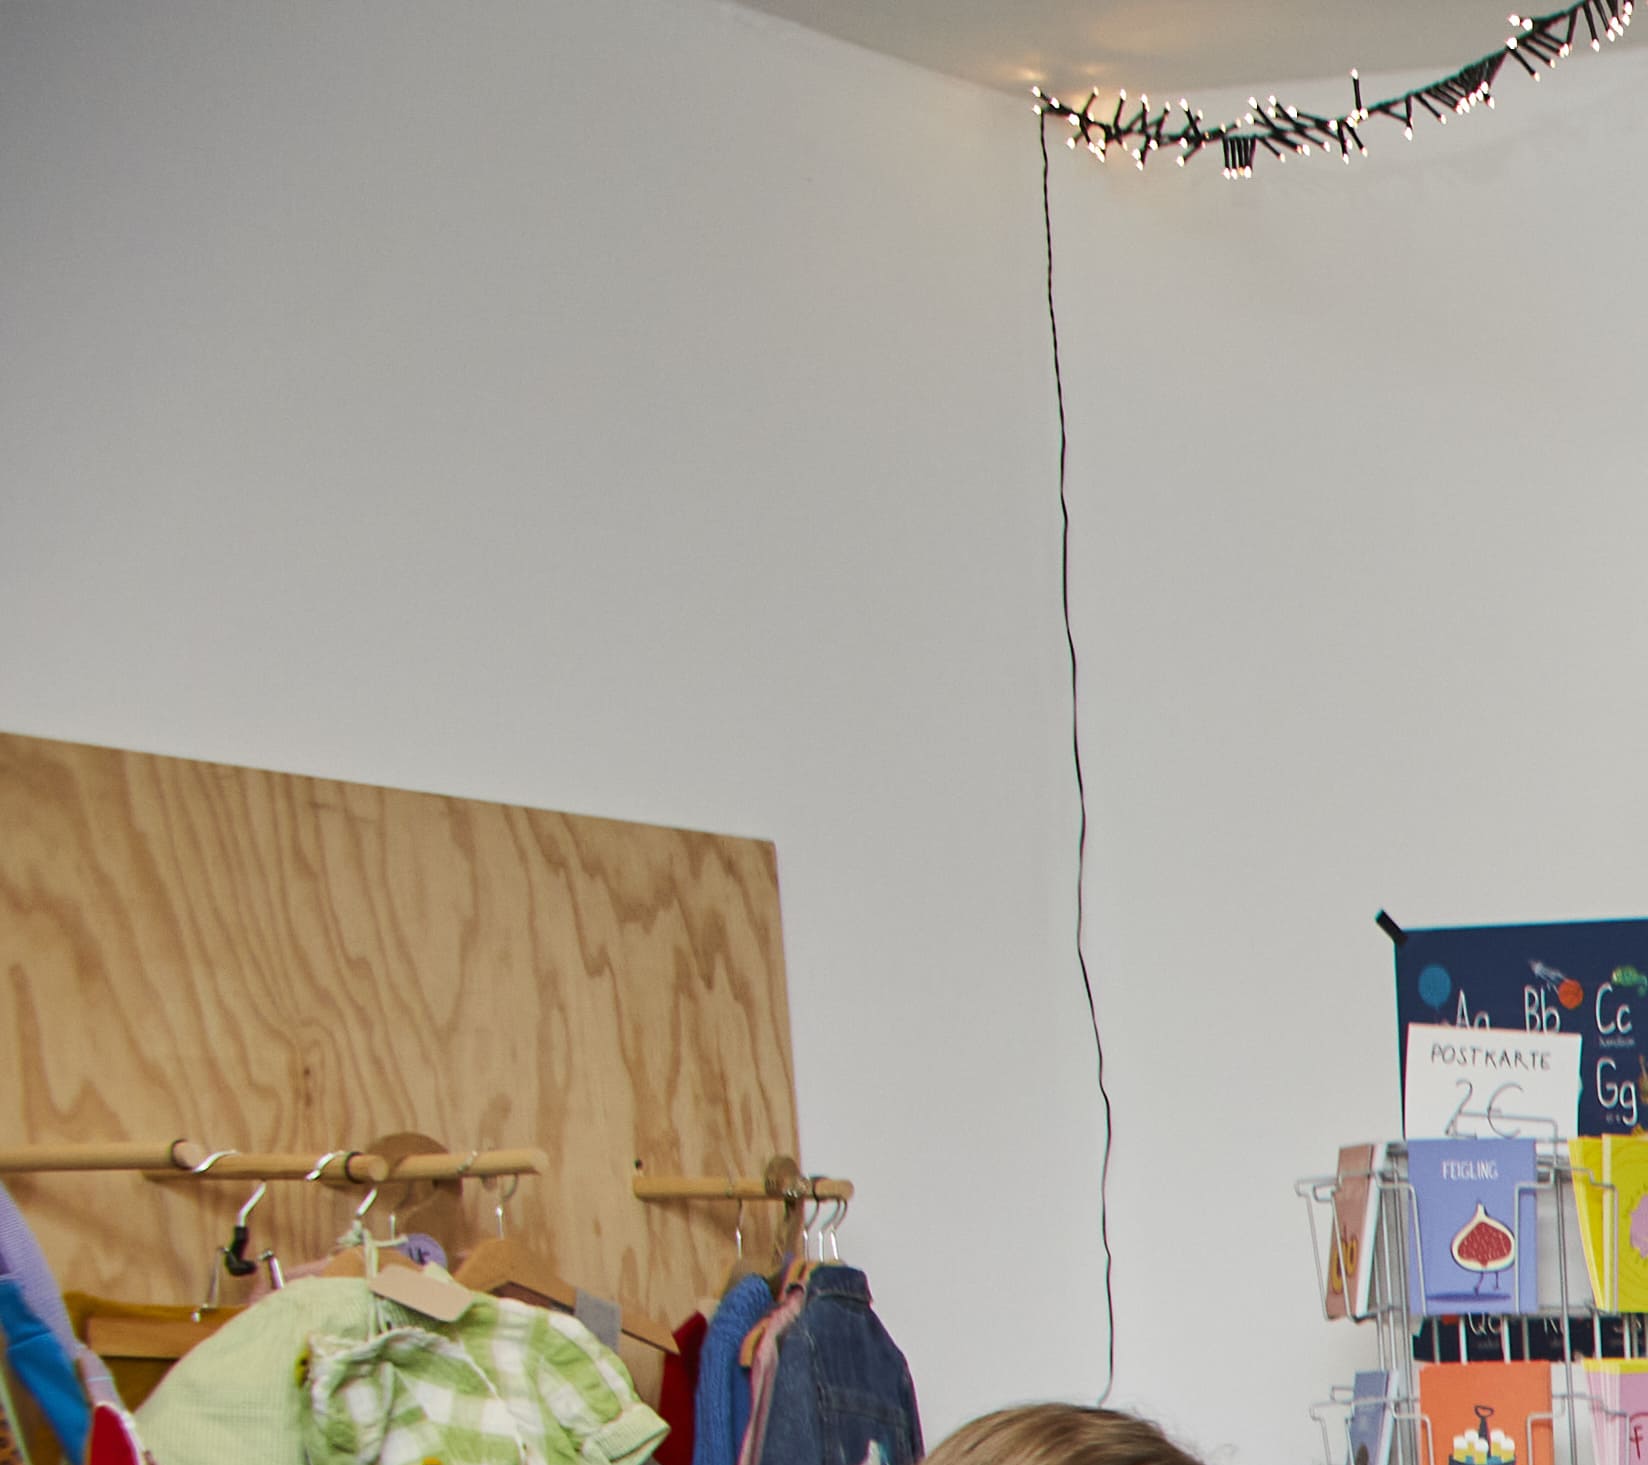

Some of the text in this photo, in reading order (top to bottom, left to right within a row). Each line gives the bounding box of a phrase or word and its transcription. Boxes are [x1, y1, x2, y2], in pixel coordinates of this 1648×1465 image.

[1524, 984, 1560, 1033] Bb
[1595, 982, 1633, 1035] Cc
[1431, 1043, 1552, 1071] POSTKARTE
[1596, 1057, 1639, 1127] Gg
[1442, 1160, 1499, 1181] FEIGLING
